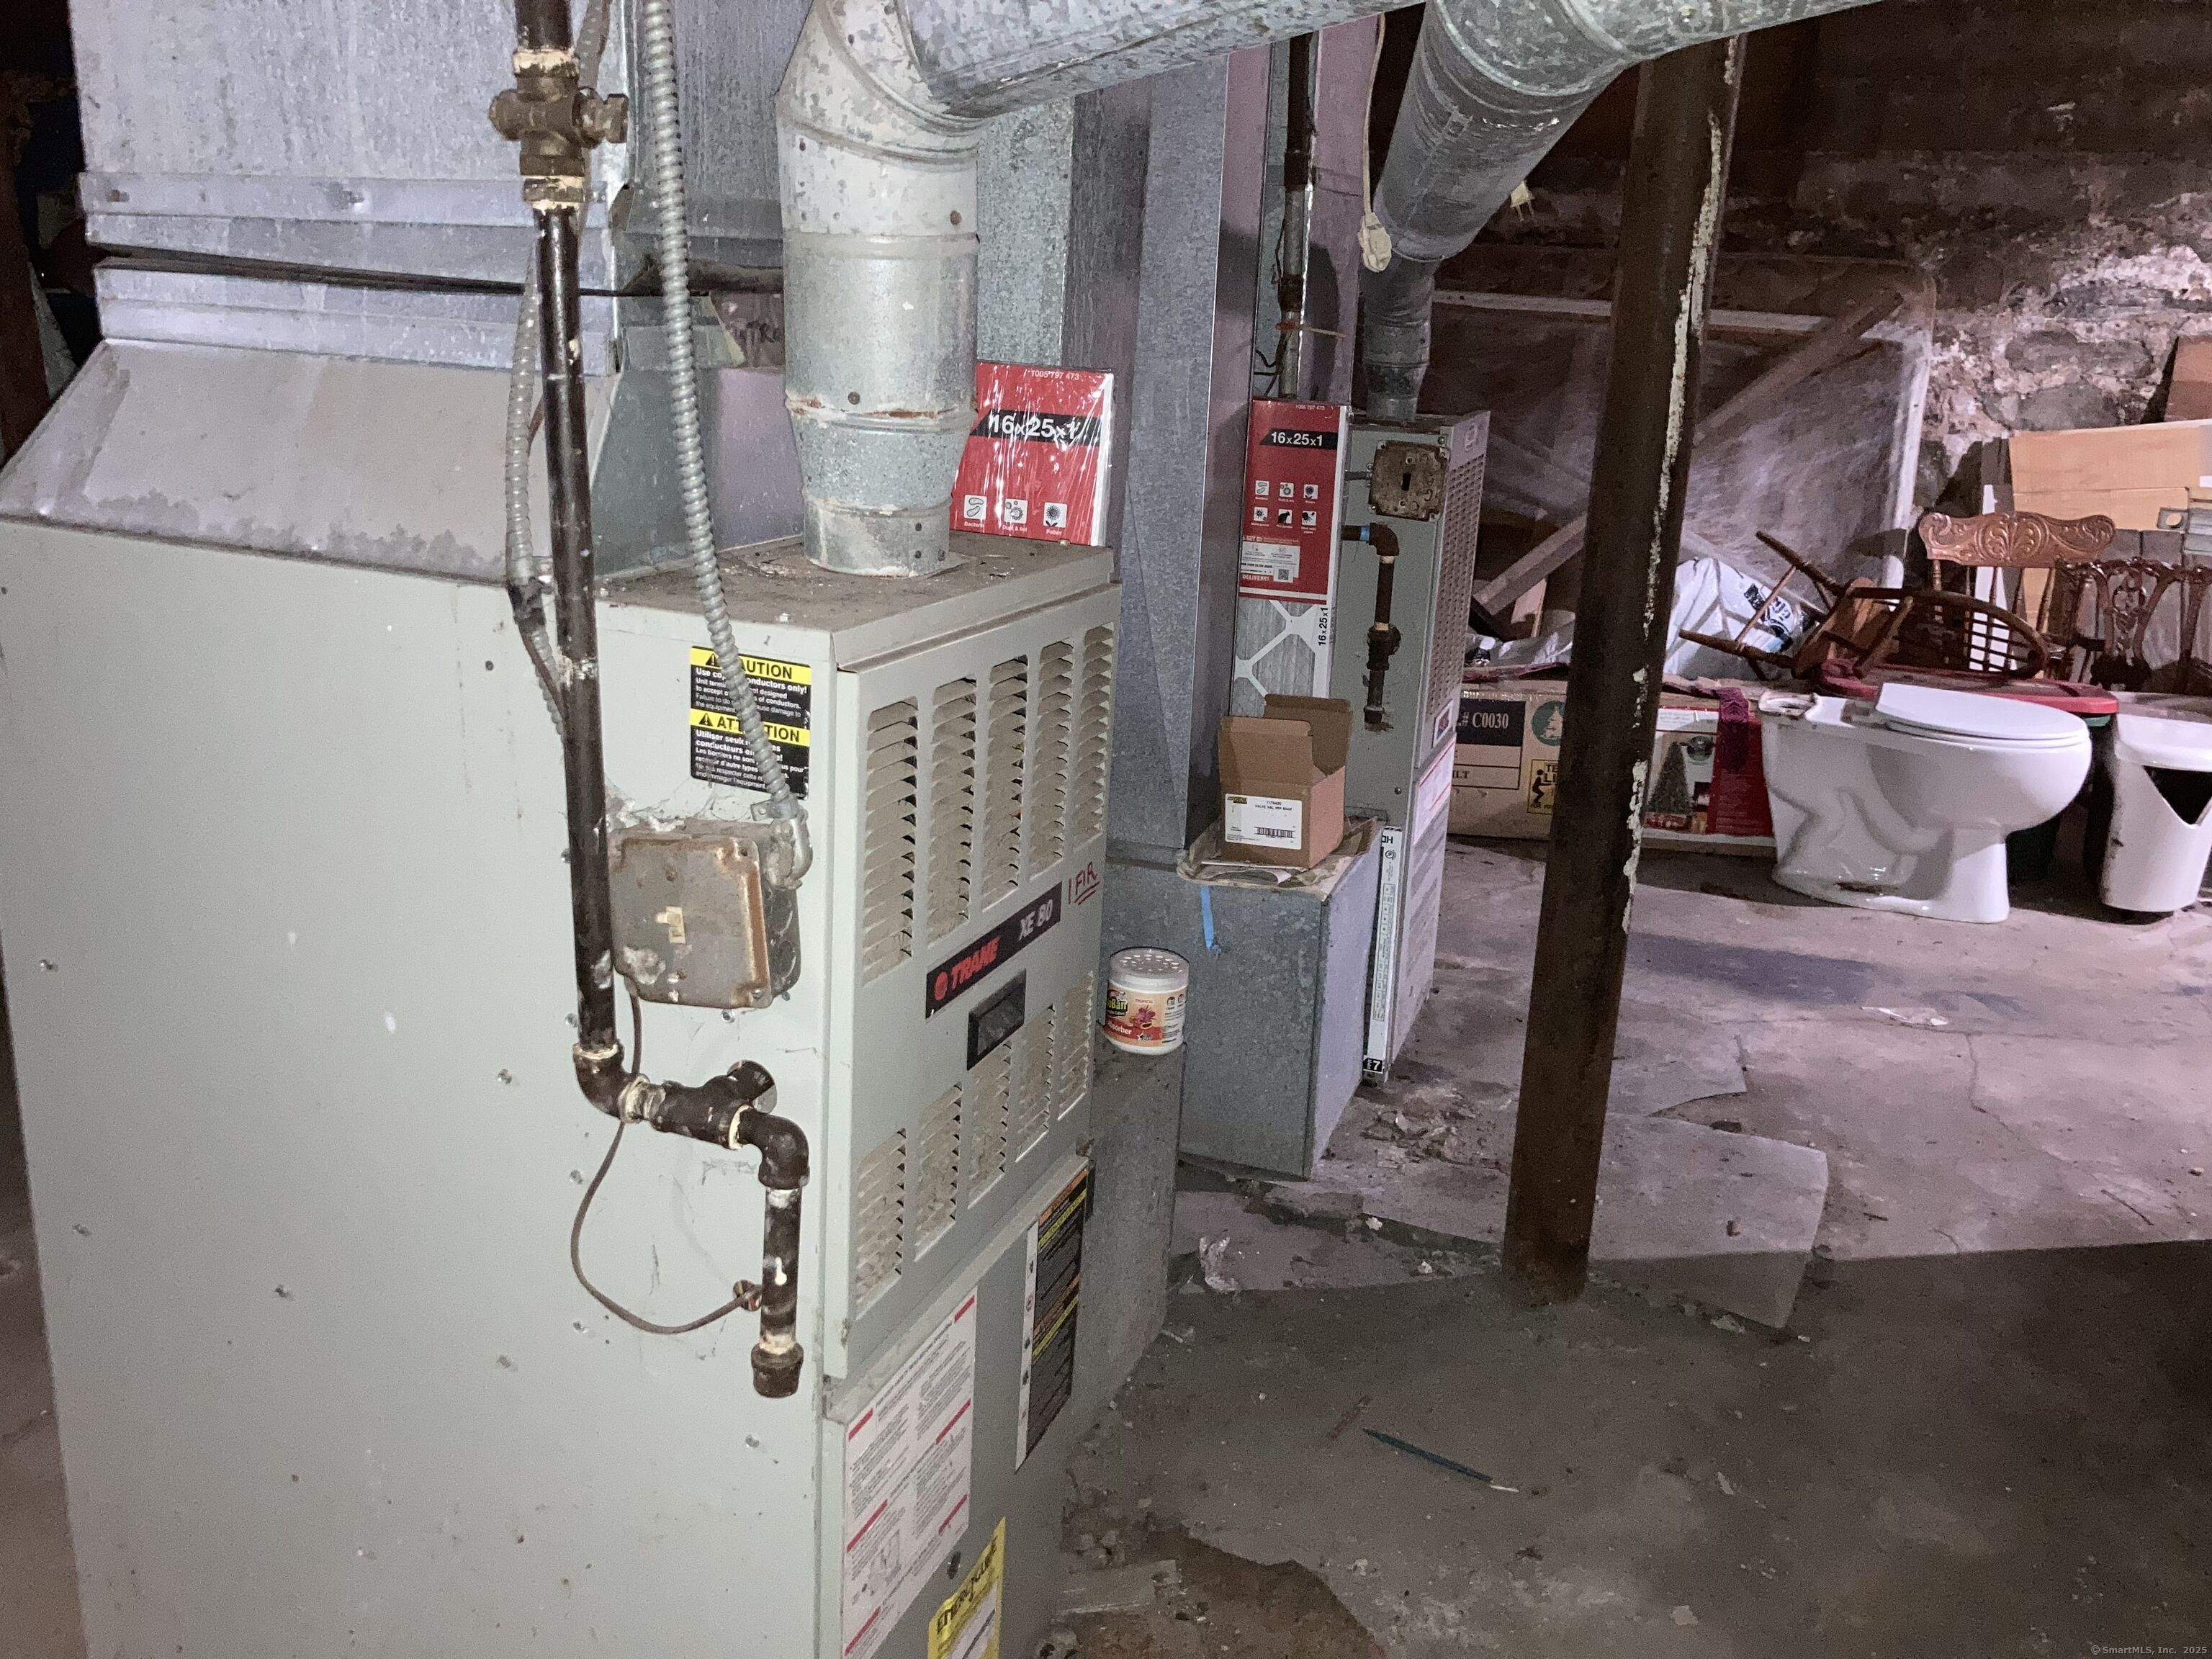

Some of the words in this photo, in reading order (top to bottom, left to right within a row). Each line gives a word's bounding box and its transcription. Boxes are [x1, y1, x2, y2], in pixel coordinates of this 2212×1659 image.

[990, 413, 1076, 439] 16x25x1
[1271, 431, 1323, 446] 16x25x1
[1318, 607, 1328, 646] 16x25x1
[696, 667, 711, 677] Use
[787, 684, 807, 696] only!
[1472, 711, 1509, 729] C0030
[696, 729, 724, 742] Utiliser
[696, 740, 744, 754] conducteurs
[951, 936, 1000, 990] TRANE
